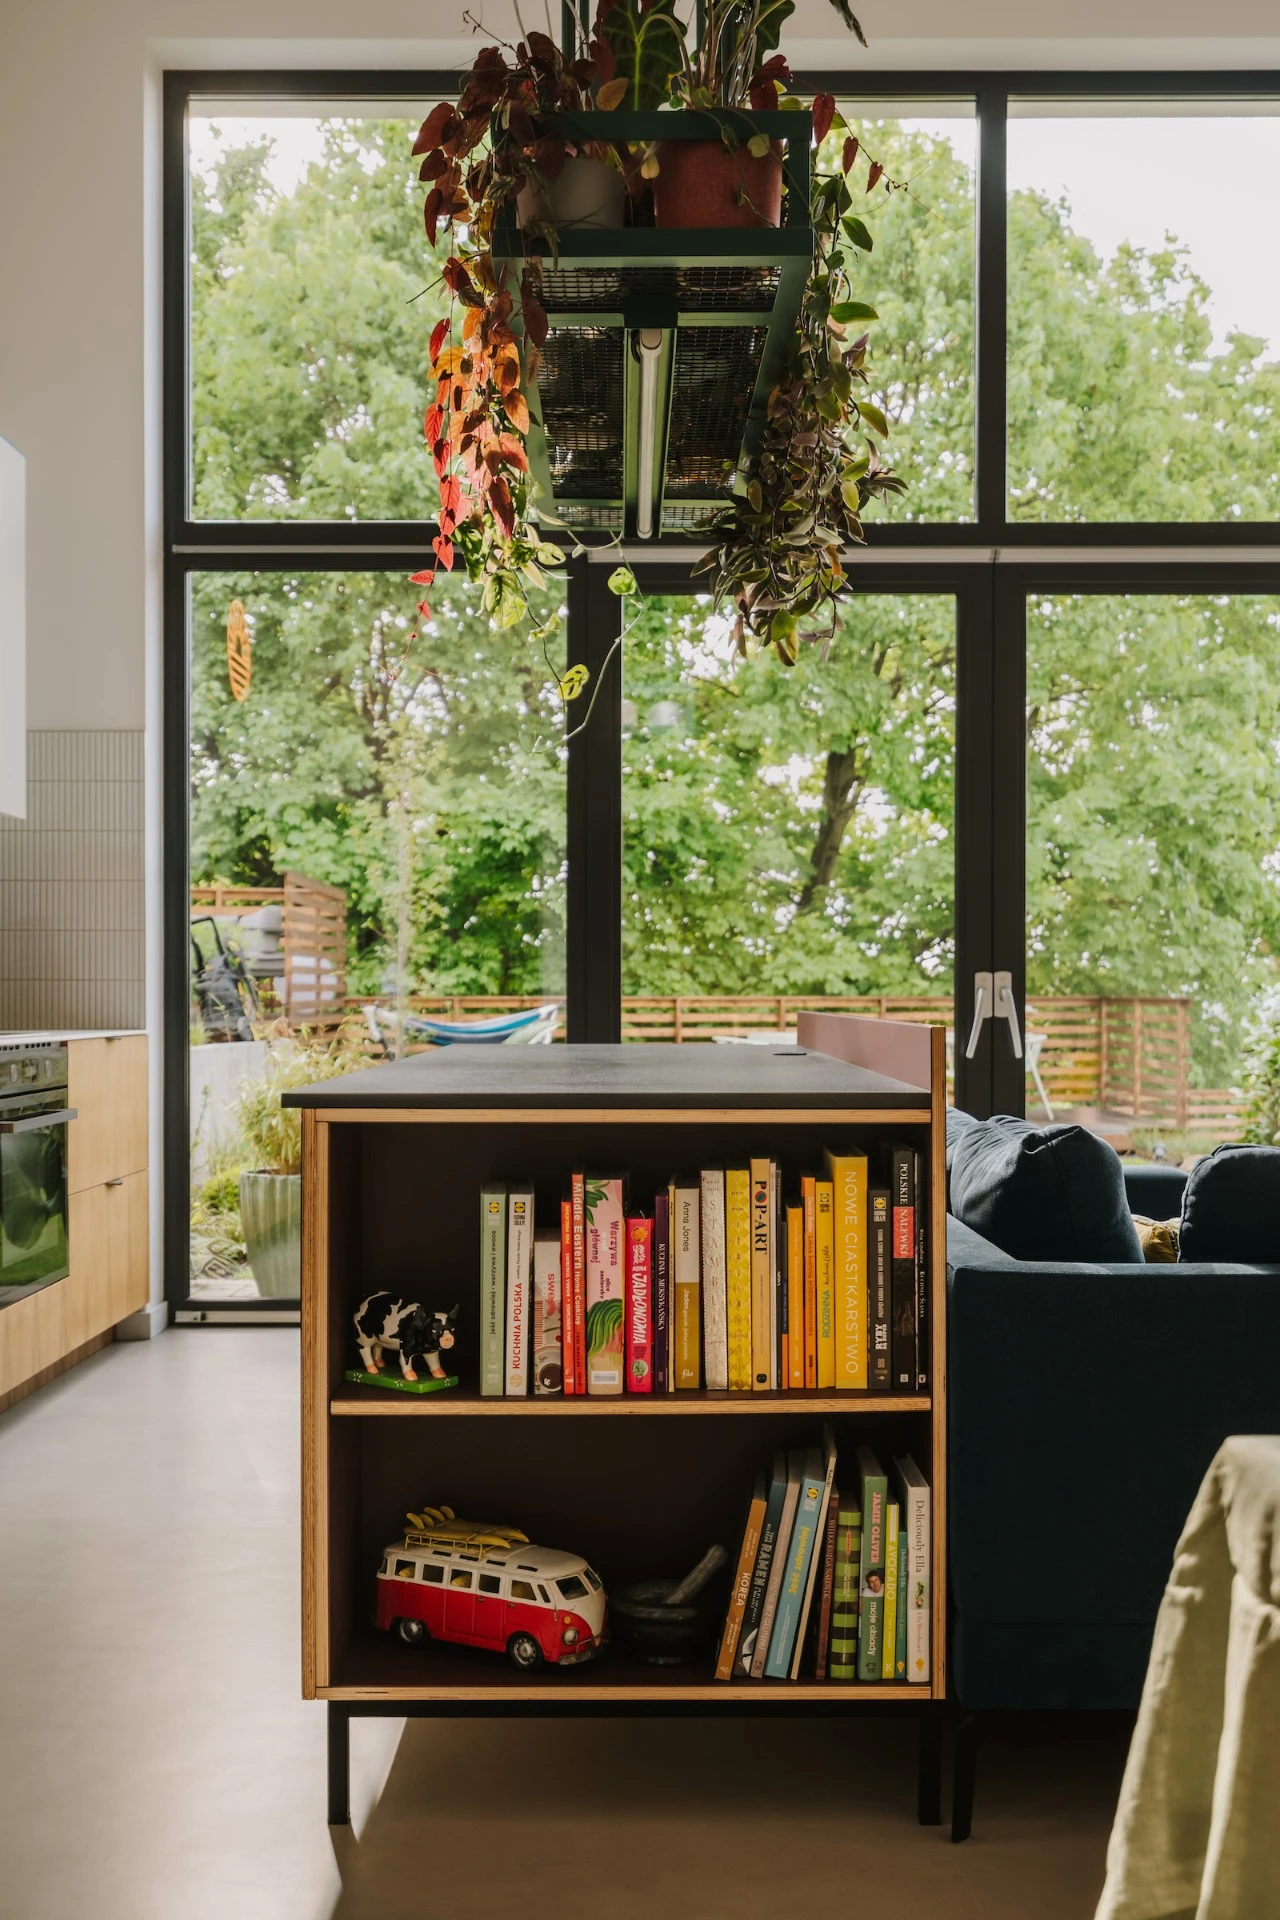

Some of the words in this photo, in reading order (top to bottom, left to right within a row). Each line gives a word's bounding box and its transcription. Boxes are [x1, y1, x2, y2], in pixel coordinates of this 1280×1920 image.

[573, 1183, 582, 1220] Middle
[845, 1171, 858, 1224] NOWE
[900, 1163, 908, 1205] POLSKIE
[754, 1180, 767, 1254] POP-ART
[574, 1226, 582, 1269] Eastern
[590, 1228, 600, 1264] głównej
[609, 1220, 620, 1266] Warzywa
[514, 1282, 522, 1322] POLSKA
[632, 1272, 646, 1344] JADŁONOMIA
[845, 1232, 858, 1374] CIASTKARSTWO
[512, 1325, 521, 1369] KUCHNIA
[872, 1492, 881, 1524] JAMIE
[912, 1499, 924, 1552] Deliciously
[754, 1543, 772, 1586] RAMEN
[788, 1572, 800, 1594] Jeść
[794, 1526, 810, 1570] zdrowiej
[871, 1526, 880, 1564] OLIVER
[915, 1555, 924, 1572] Ella
[736, 1572, 750, 1606] KOREA
[886, 1544, 896, 1599] AVOCADO
[765, 1604, 773, 1617] BEZ
[868, 1601, 877, 1623] moje
[758, 1617, 771, 1650] GLUTENU
[868, 1625, 877, 1656] obiady
